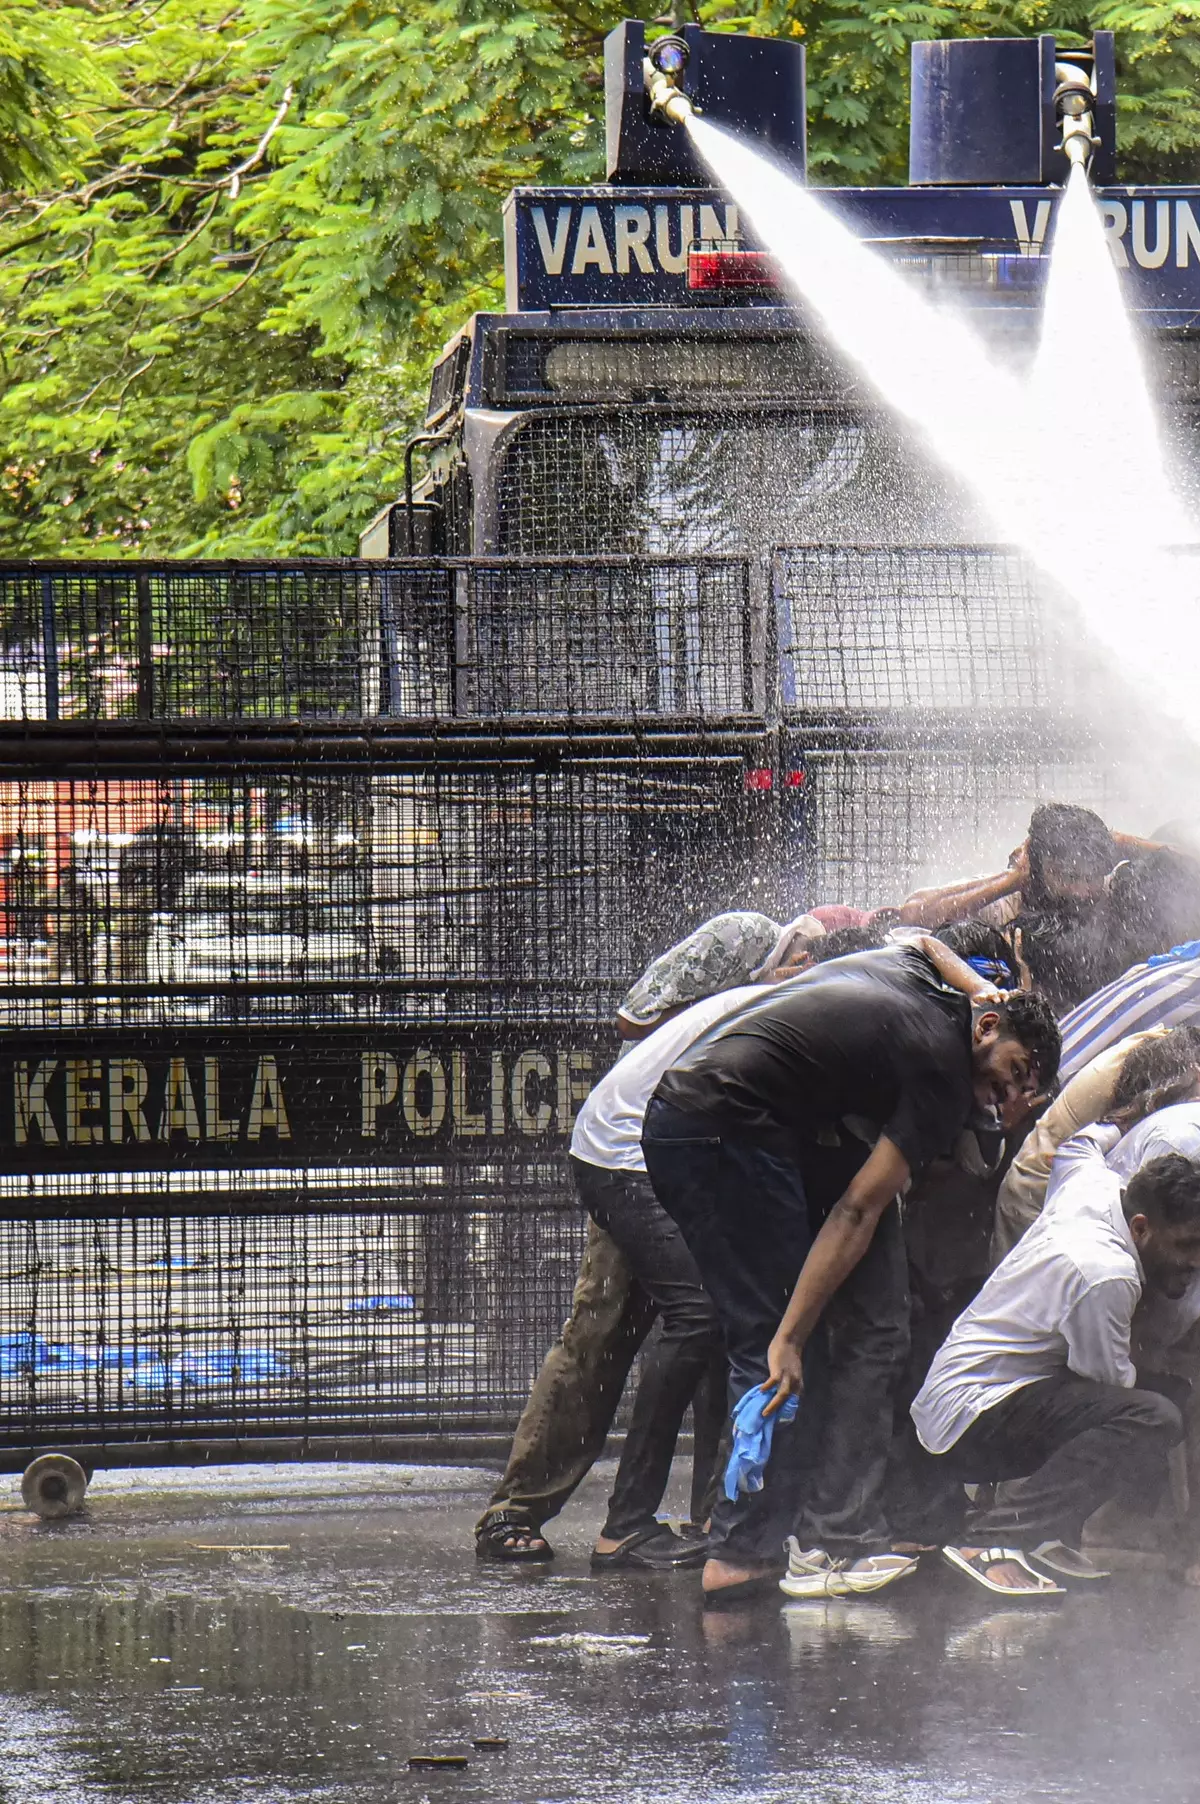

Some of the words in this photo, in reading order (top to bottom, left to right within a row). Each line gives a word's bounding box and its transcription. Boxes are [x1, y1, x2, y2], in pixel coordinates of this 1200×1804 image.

[531, 205, 738, 275] VARUN
[13, 1054, 292, 1147] KERALA
[360, 1049, 593, 1137] POLICE
